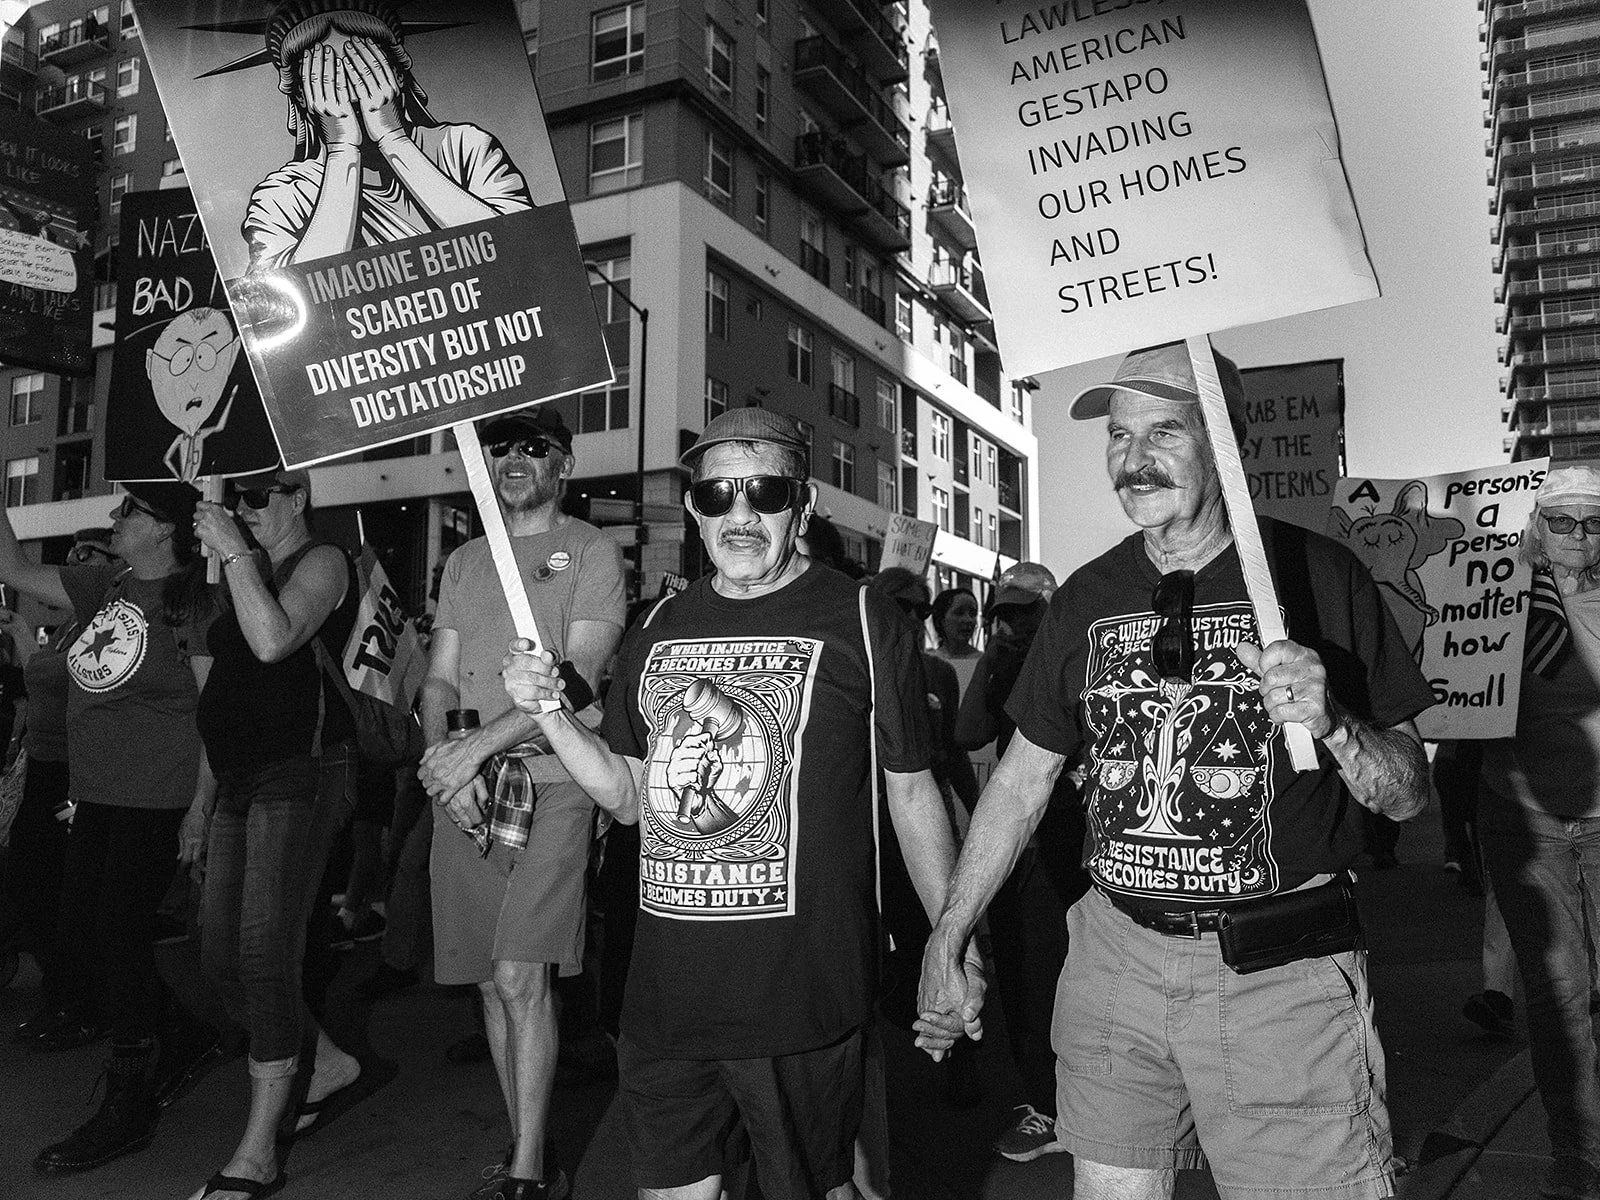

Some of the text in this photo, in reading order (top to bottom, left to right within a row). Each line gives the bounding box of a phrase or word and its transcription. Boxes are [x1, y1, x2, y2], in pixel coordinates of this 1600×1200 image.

[1010, 15, 1186, 85] AMERICAN
[1018, 67, 1168, 127] GESTAPO
[1028, 111, 1192, 175] INVADING
[1038, 146, 1247, 219] OUR HOMES
[1050, 227, 1120, 266] AND
[305, 231, 498, 305] IMAGINE BEING
[1058, 253, 1218, 314] STREETS!
[133, 276, 194, 316] BAD
[345, 277, 483, 340] SCARED OF
[305, 306, 544, 396] DIVERSITY BUT NOT
[349, 354, 526, 429] DICTATORSHIP
[1271, 433, 1312, 458] THE
[1347, 469, 1546, 510] A person's
[1475, 503, 1500, 528] a
[1466, 556, 1515, 587] no
[1440, 586, 1531, 623] matter
[670, 641, 788, 656] WHEN INJUSTICE
[1117, 617, 1162, 642] WHEN
[1204, 628, 1240, 651] LAW
[1443, 630, 1511, 658] how
[658, 655, 789, 672] BECOMES LAW
[1098, 857, 1243, 895] BECOMES DUTY
[1108, 839, 1225, 875] RESISTANCE
[646, 883, 771, 907] BECOMES DUTY
